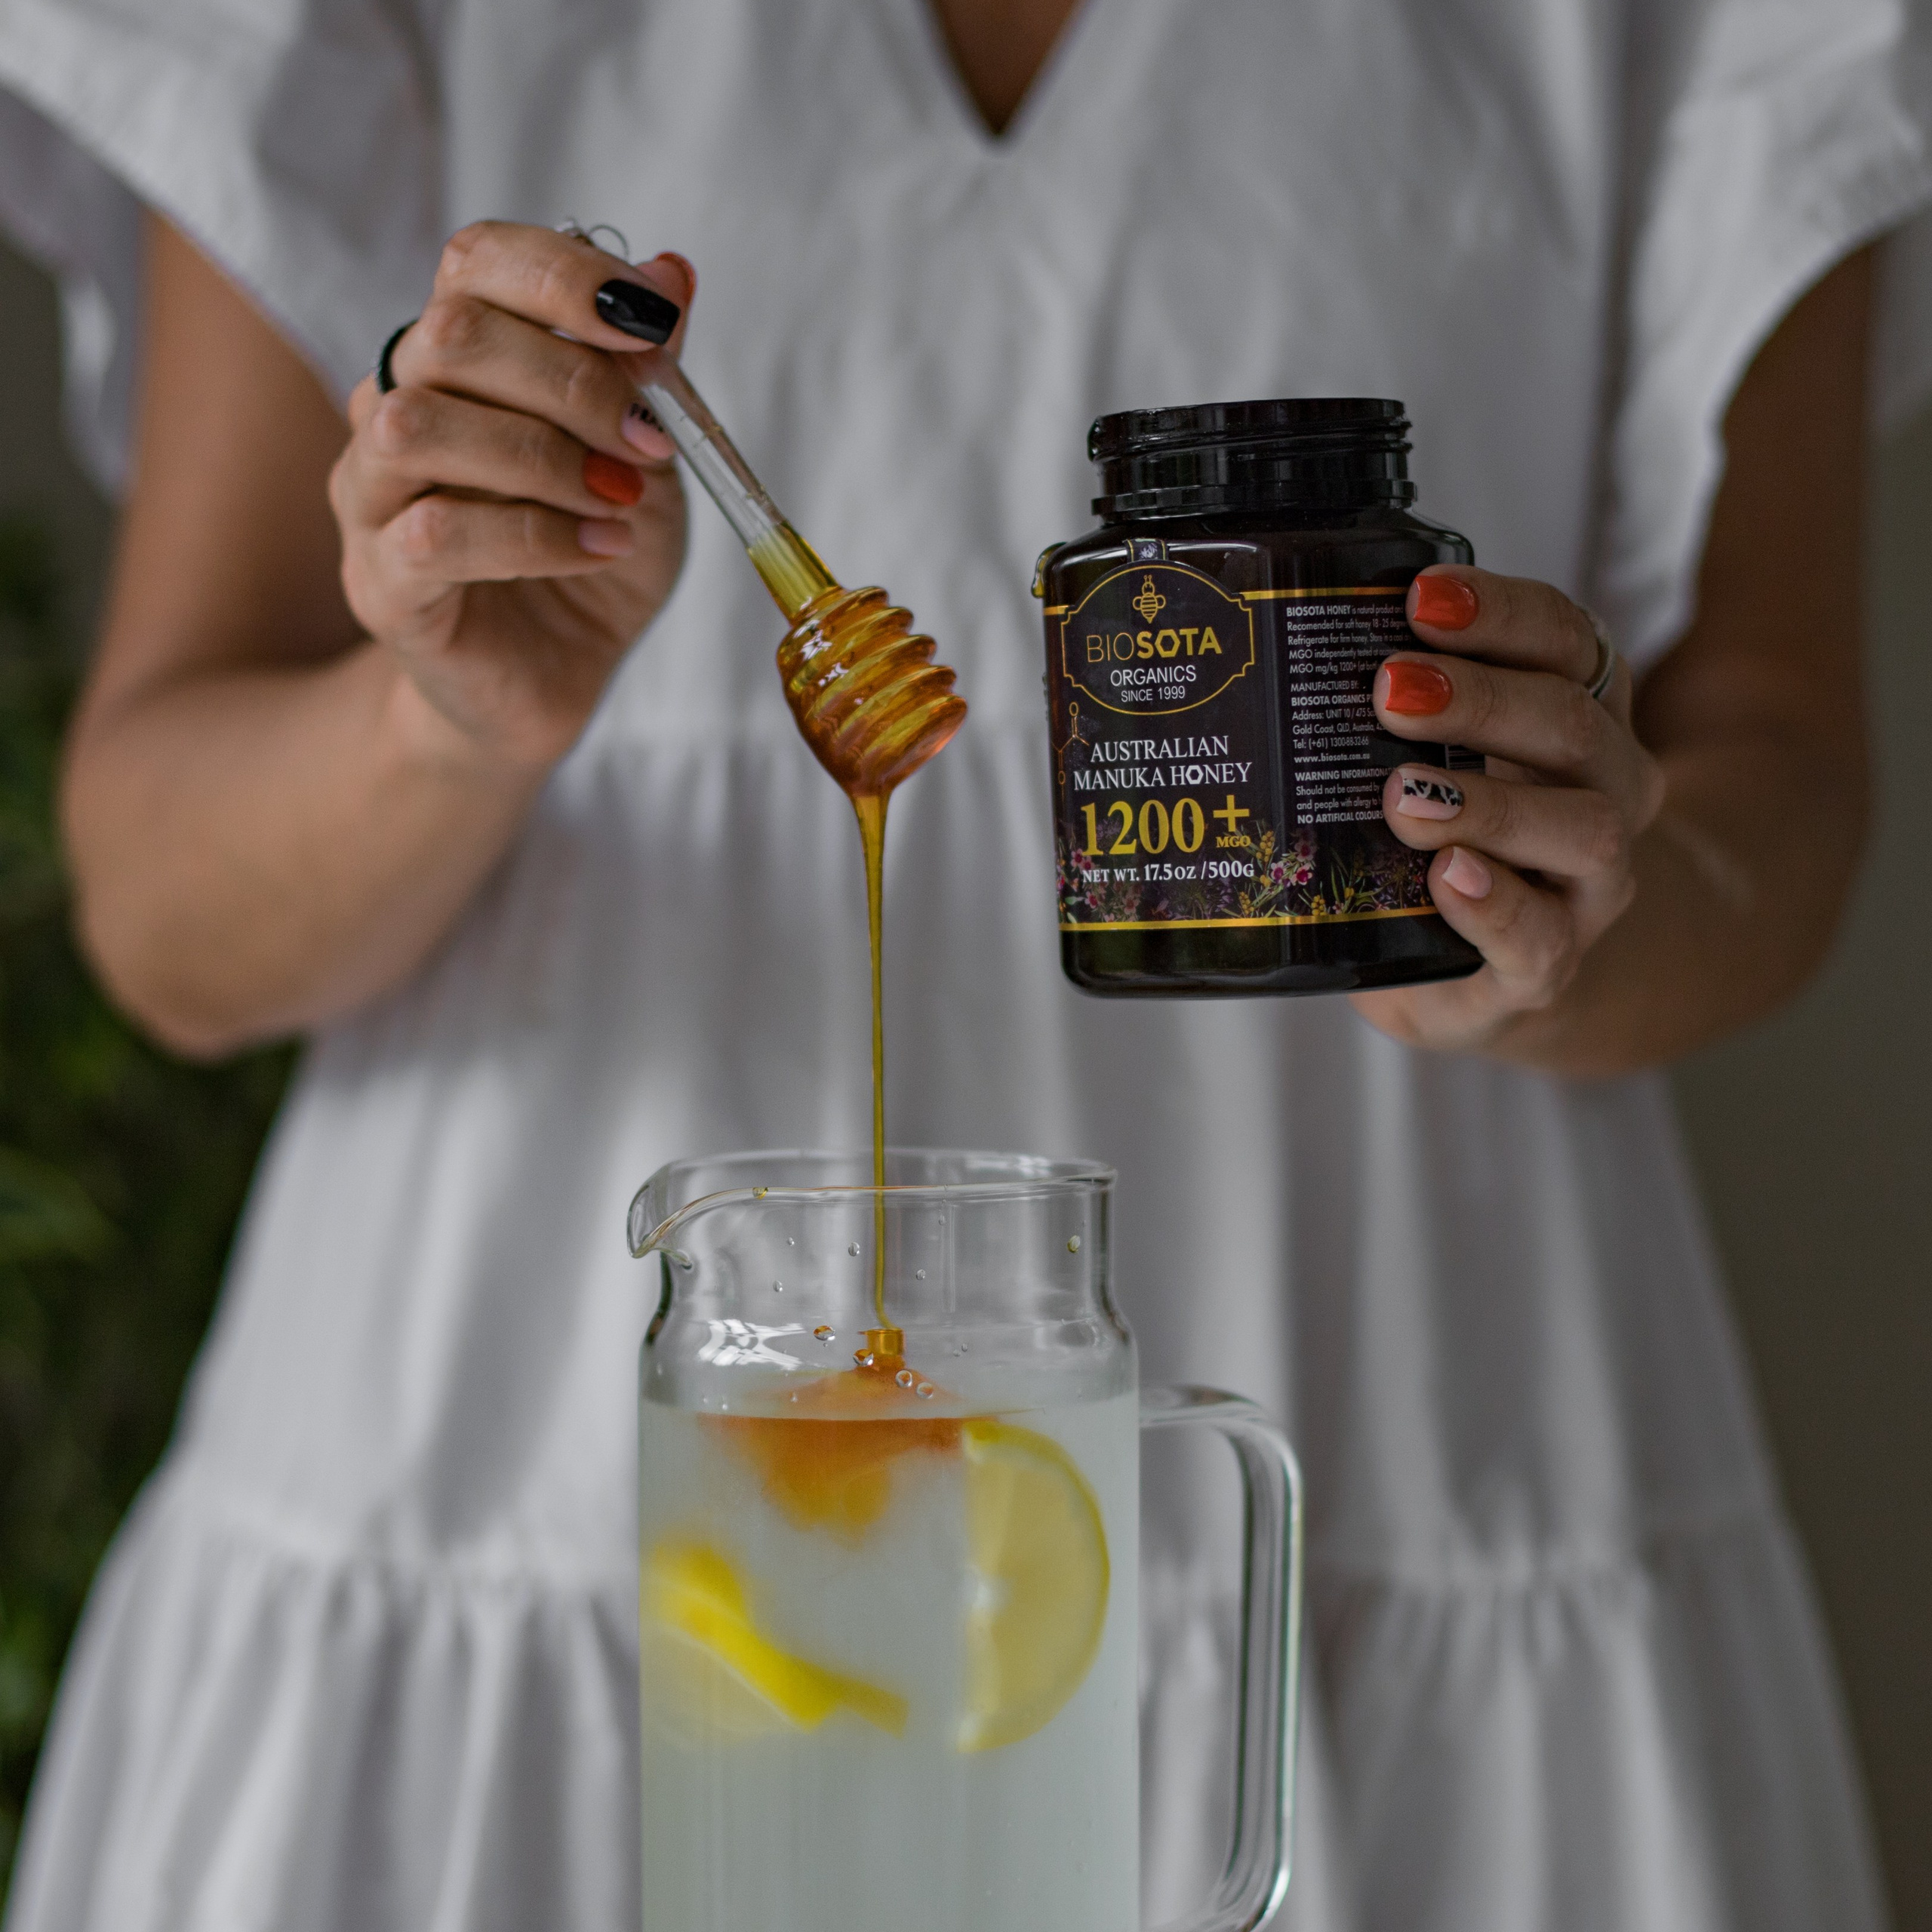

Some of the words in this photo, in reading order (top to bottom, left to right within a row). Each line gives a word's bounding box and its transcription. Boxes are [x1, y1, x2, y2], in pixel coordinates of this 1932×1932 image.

[1287, 606, 1325, 617] BIOSOTA
[1327, 605, 1351, 615] HONEY
[1357, 605, 1374, 614] natural
[1375, 604, 1394, 616] product
[1287, 620, 1334, 631] Recomended
[1335, 619, 1344, 629] for
[1345, 618, 1354, 629] soft
[1355, 618, 1371, 631] honey
[1372, 618, 1379, 628] 18
[1382, 618, 1389, 628] 25
[1086, 626, 1223, 663] BIOSOTA
[1287, 634, 1329, 647] Refrigerate
[1330, 632, 1339, 643] for
[1340, 633, 1350, 642] firm
[1370, 632, 1383, 642] Store
[1289, 649, 1313, 660] MGO
[1314, 648, 1356, 660] independently
[1357, 648, 1373, 657] tested
[1290, 663, 1313, 674] MGO
[1315, 662, 1338, 675] mg/kg
[1340, 662, 1356, 672] 1200+
[1110, 665, 1196, 687] ORGANICS
[1291, 681, 1349, 692] MANUFACTURED
[1121, 688, 1153, 703] SINCE
[1158, 685, 1186, 700] 1999
[1291, 696, 1330, 706] BIOSOTA
[1331, 694, 1365, 704] ORGANICS
[1292, 710, 1324, 721] Address:
[1326, 709, 1343, 718] UNIT
[1343, 709, 1350, 718] 10
[1293, 724, 1312, 734] Gold
[1314, 724, 1335, 734] Coast,
[1091, 735, 1229, 762] AUSTRALIAN
[1293, 738, 1306, 749] Tel:
[1309, 737, 1328, 750] (+61)
[1294, 753, 1370, 763] www.biosota.com.au
[1073, 767, 1166, 791] MANUKA
[1170, 761, 1253, 786] HONEY
[1295, 771, 1340, 781] WARNING
[1296, 785, 1323, 795] Should
[1324, 786, 1336, 795] not
[1337, 783, 1345, 793] be
[1346, 782, 1372, 793] consumed
[1373, 781, 1380, 793] by
[1297, 799, 1312, 811] and
[1315, 798, 1339, 811] people
[1340, 797, 1352, 808] with
[1353, 796, 1371, 808] allergy
[1297, 814, 1313, 824] NO
[1315, 812, 1355, 823] ARTIFICIAL
[1355, 810, 1383, 821] COLOURS
[1216, 835, 1251, 848] MGO
[1082, 869, 1109, 883] NET
[1113, 868, 1140, 881] WT.
